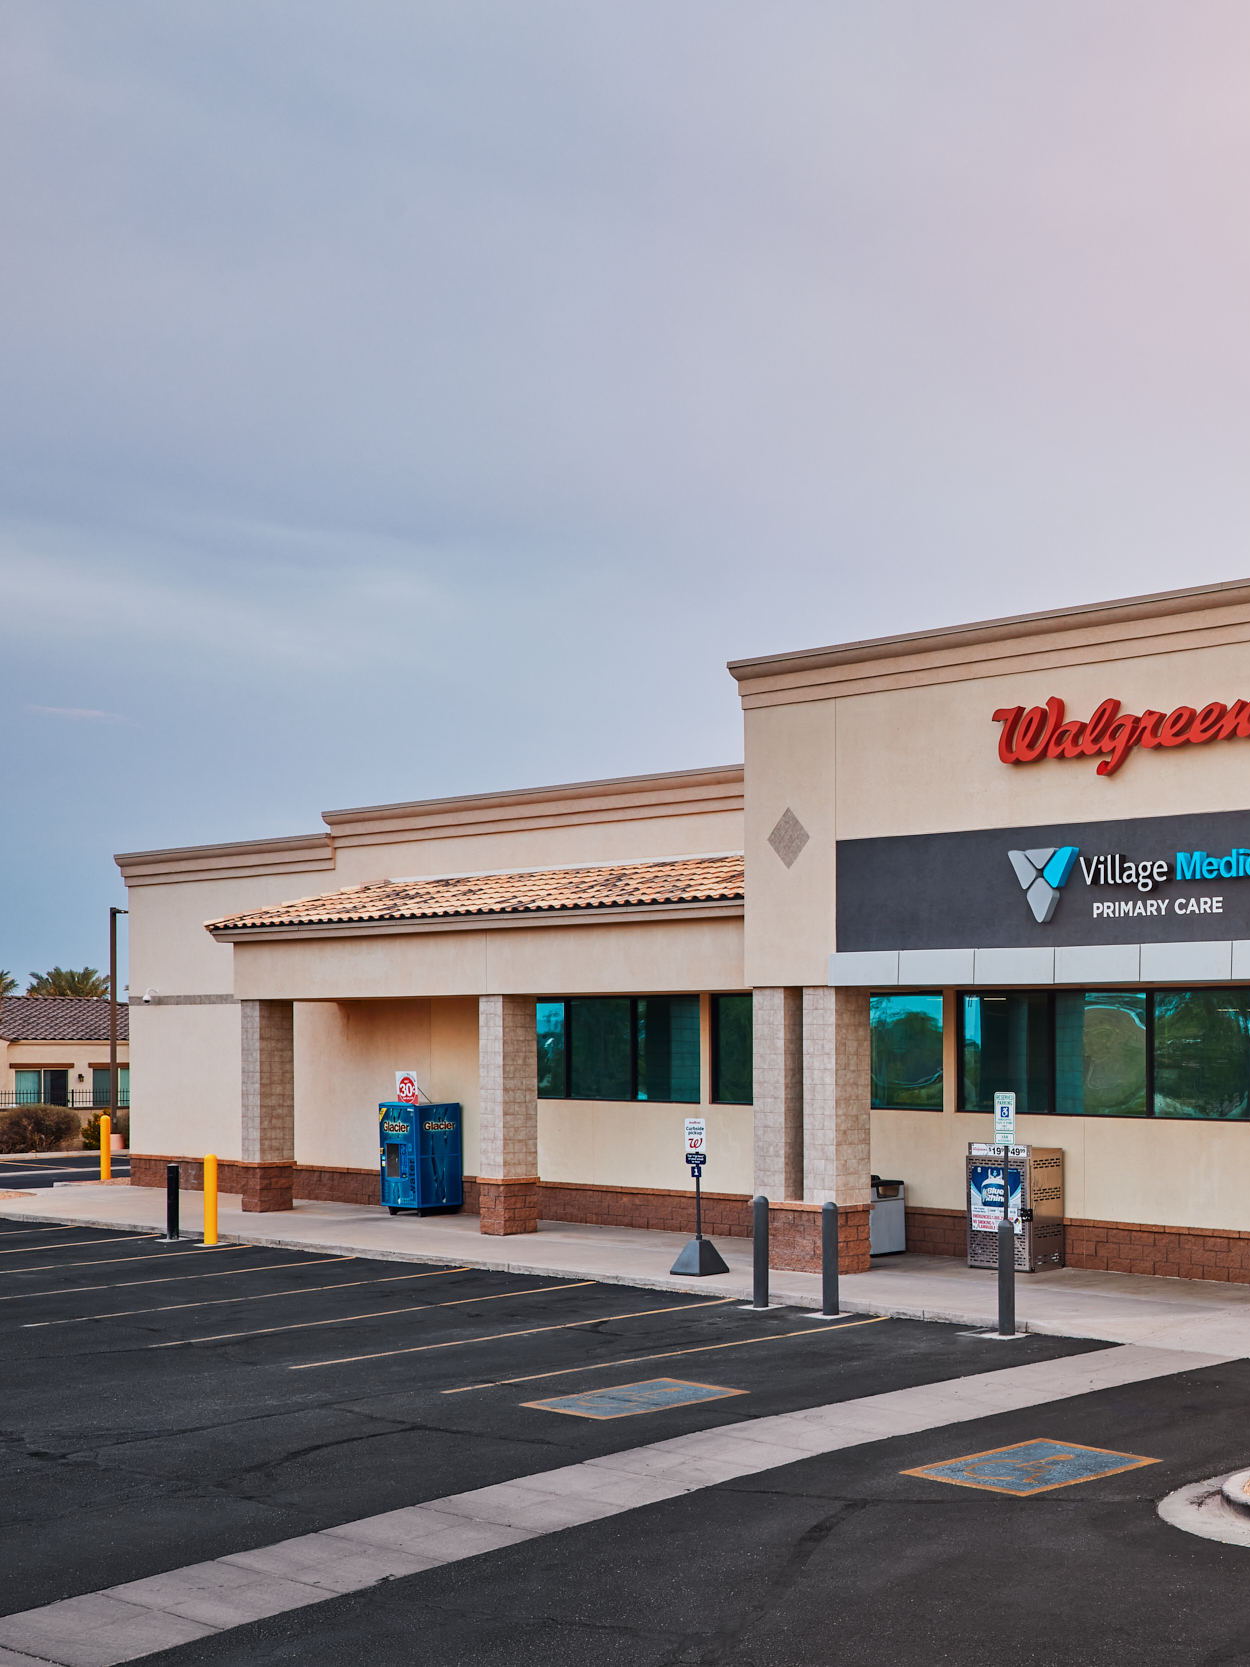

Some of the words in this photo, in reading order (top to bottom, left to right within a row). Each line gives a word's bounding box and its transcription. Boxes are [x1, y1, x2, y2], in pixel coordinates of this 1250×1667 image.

[1079, 852, 1168, 892] Village
[1092, 899, 1170, 918] PRIMARY
[1174, 897, 1223, 915] CARE
[383, 1121, 410, 1133] Glacier
[424, 1121, 456, 1131] Glacier
